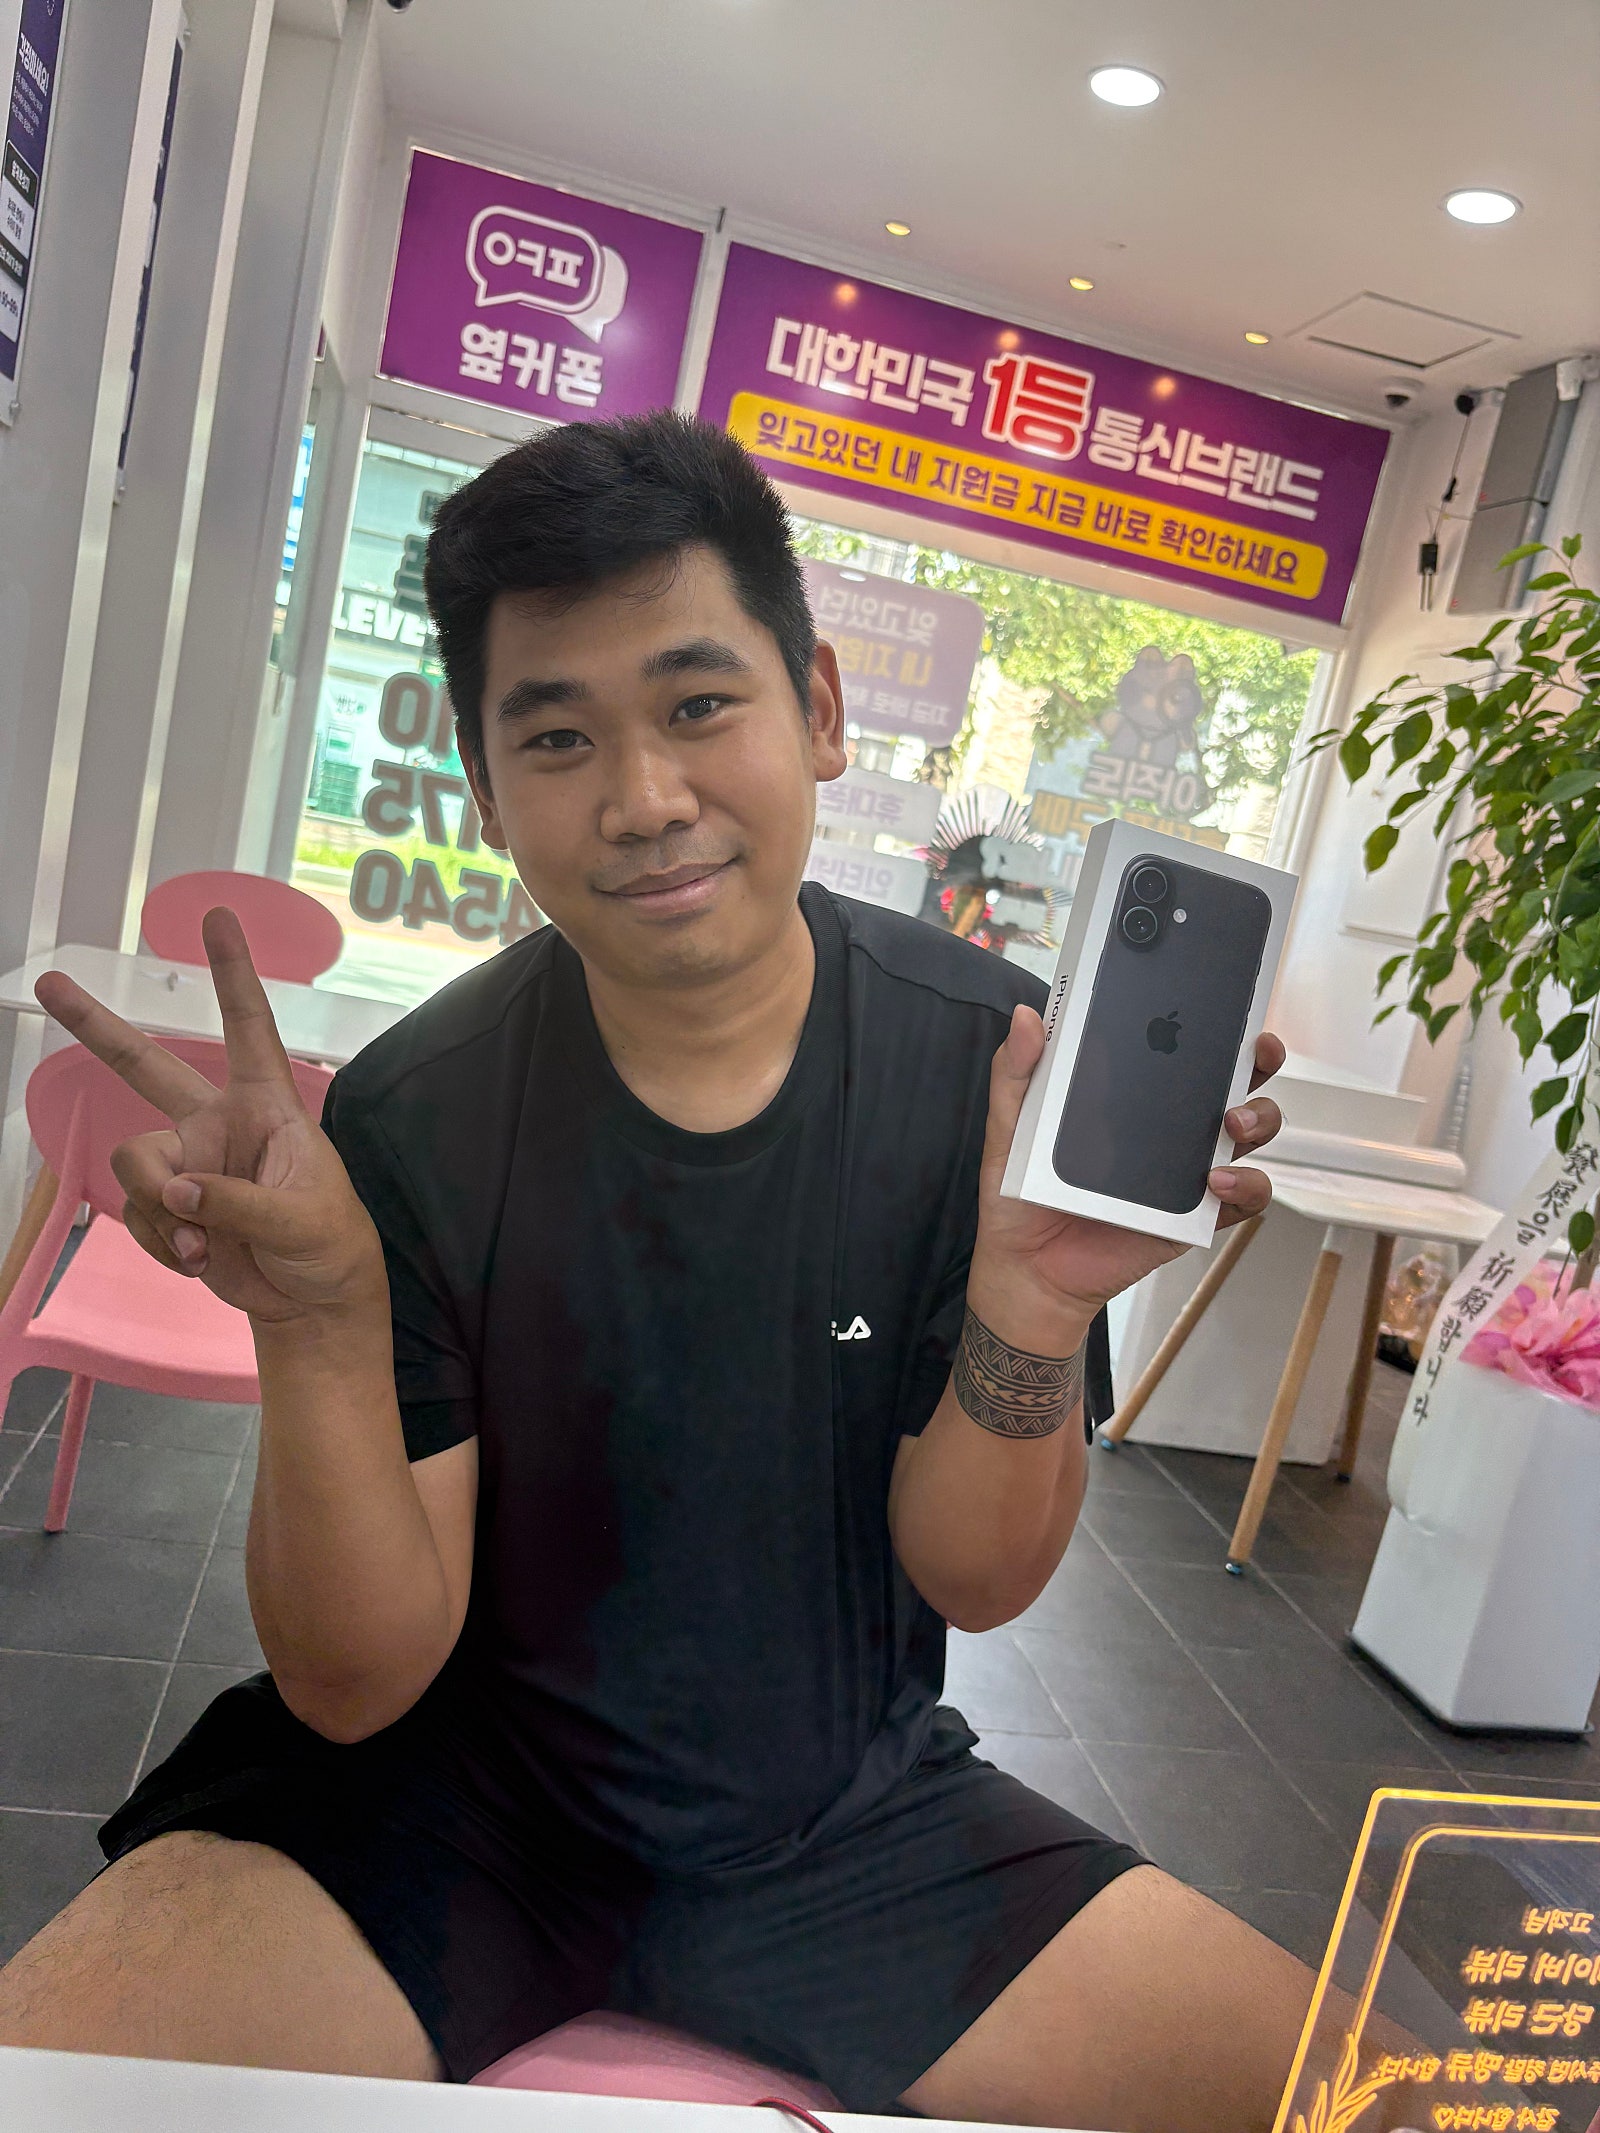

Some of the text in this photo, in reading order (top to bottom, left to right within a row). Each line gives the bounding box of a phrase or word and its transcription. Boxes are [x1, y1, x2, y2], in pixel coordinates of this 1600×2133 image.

[459, 322, 604, 408] 옆커폰
[766, 317, 1324, 521] 대한민국 1등 통신브랜드
[756, 410, 1300, 586] 잊고있던 내 지원금 지금 바로 확인하세요
[332, 588, 440, 648] LEVE
[1045, 974, 1069, 1042] iPhone
